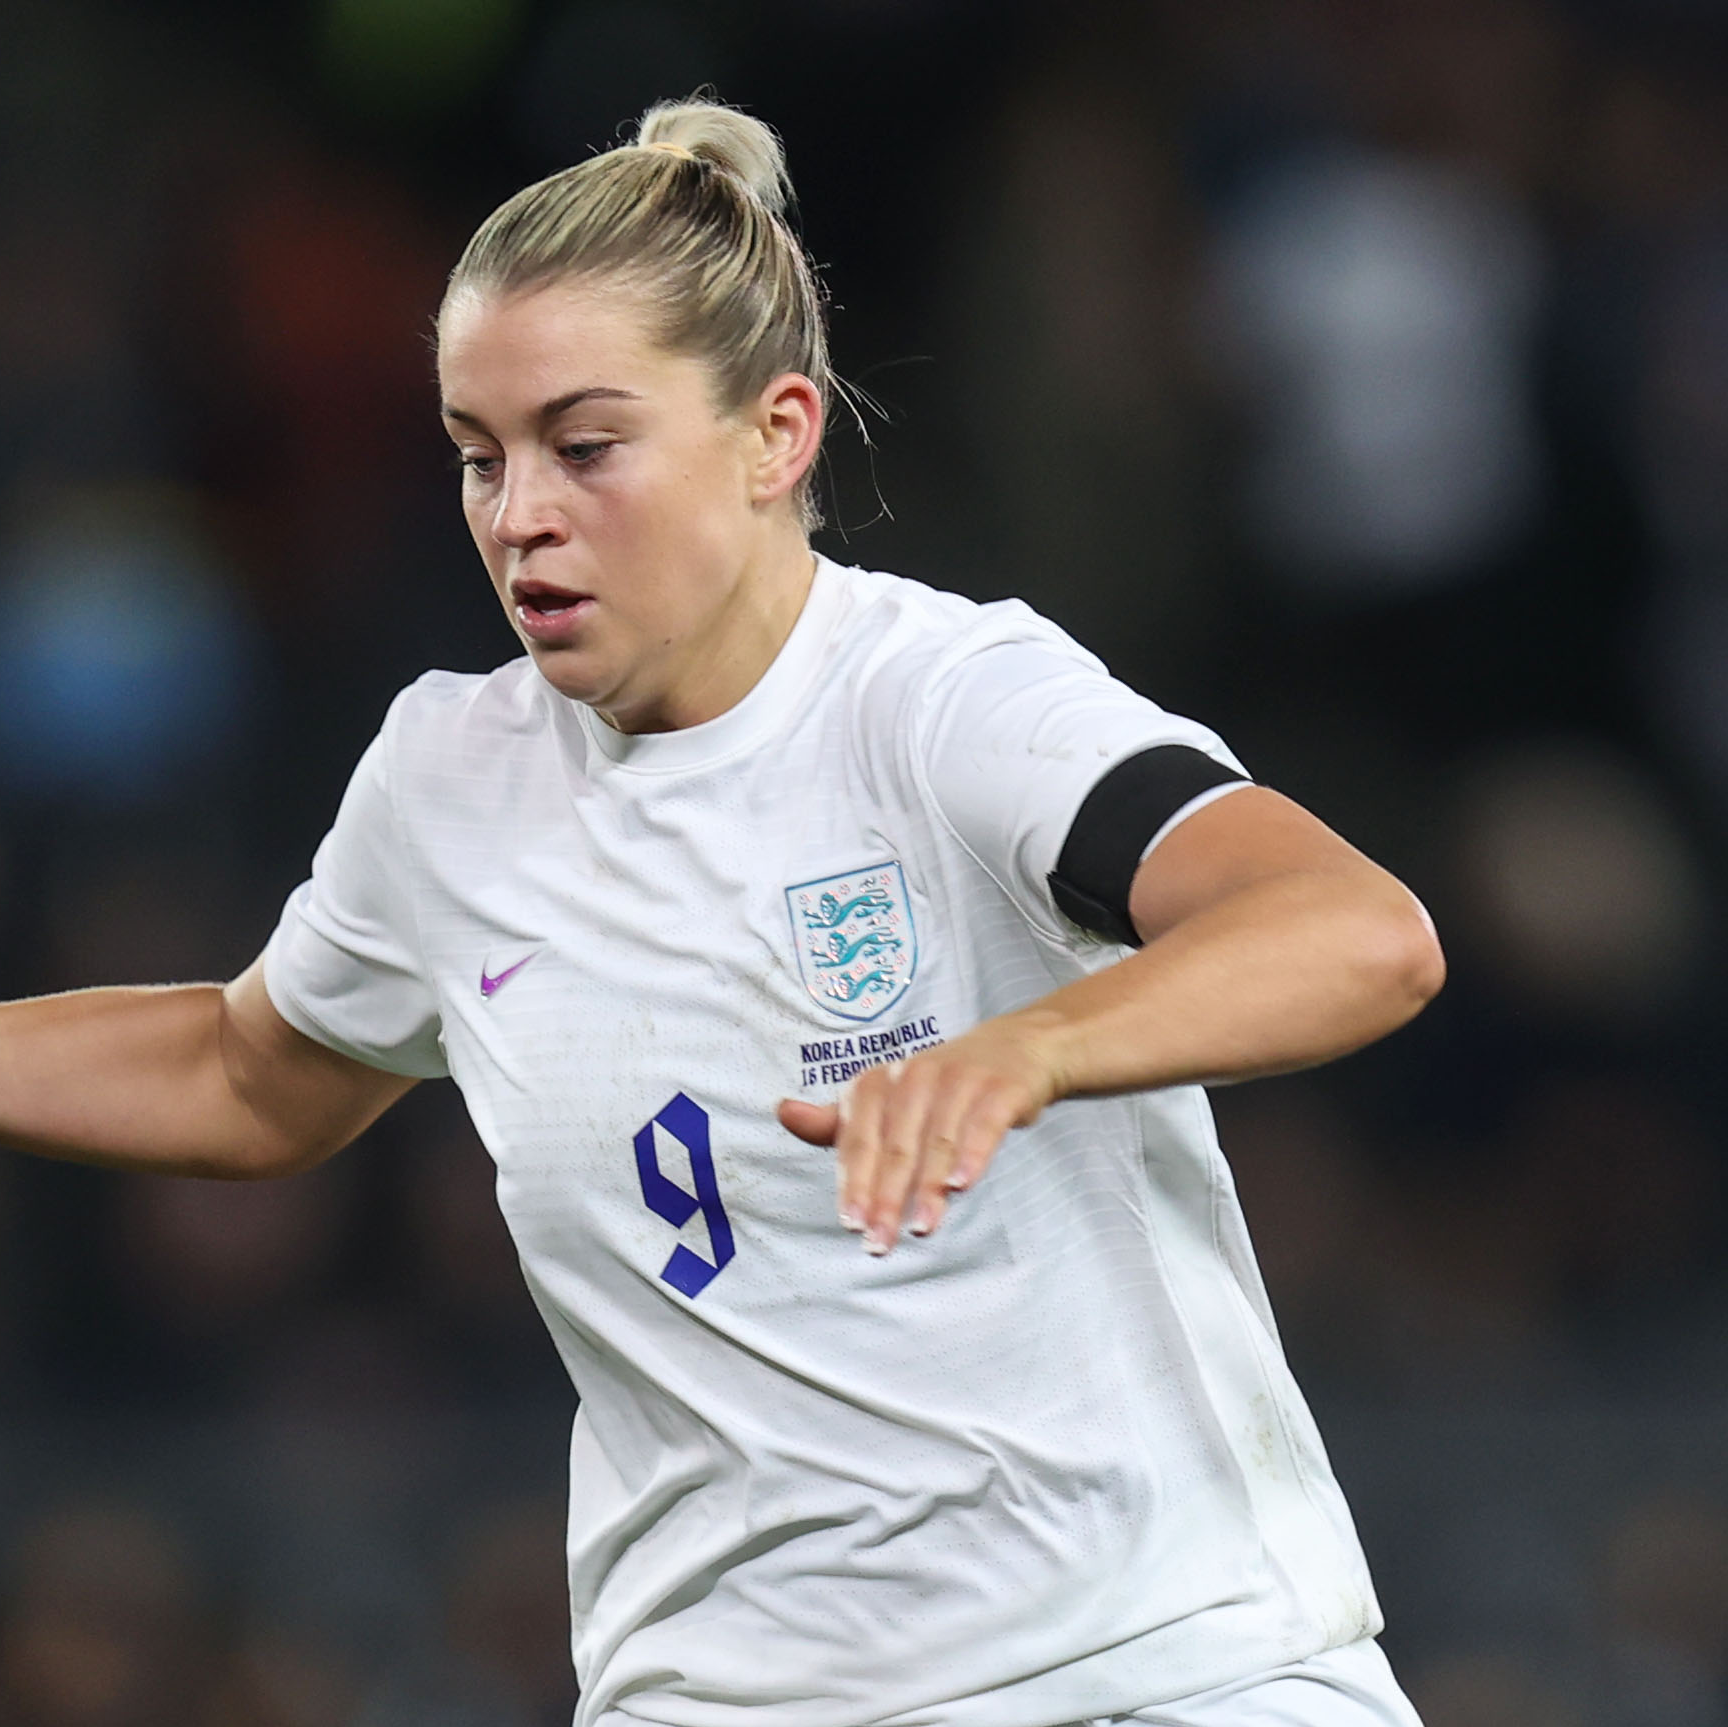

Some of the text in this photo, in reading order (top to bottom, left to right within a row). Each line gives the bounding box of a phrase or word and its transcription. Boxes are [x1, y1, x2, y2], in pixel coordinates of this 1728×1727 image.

[800, 1038, 856, 1063] KOREA
[858, 1016, 940, 1055] REPUBLIC
[801, 1067, 818, 1087] 16
[633, 1090, 736, 1300] 9
